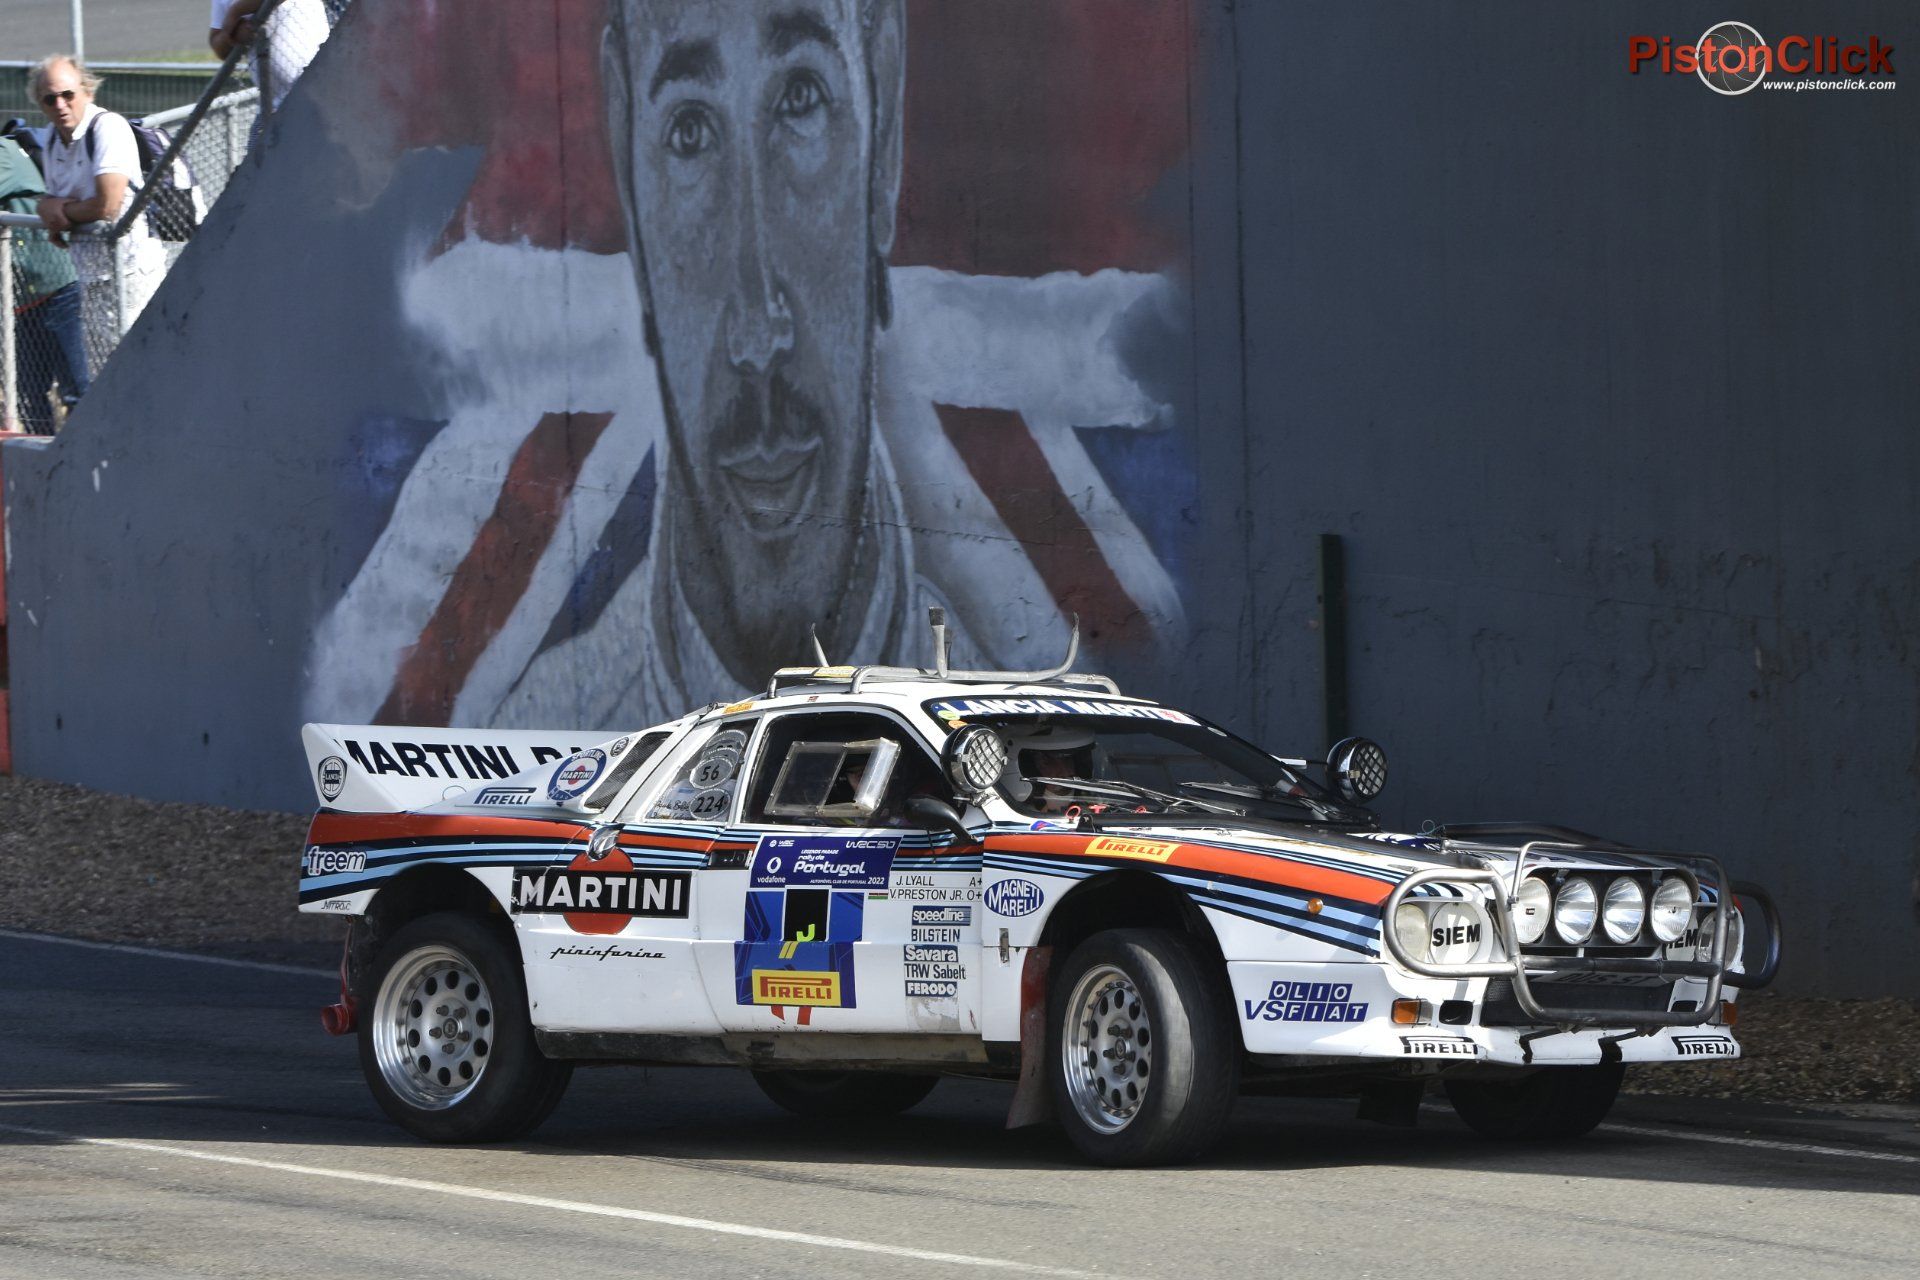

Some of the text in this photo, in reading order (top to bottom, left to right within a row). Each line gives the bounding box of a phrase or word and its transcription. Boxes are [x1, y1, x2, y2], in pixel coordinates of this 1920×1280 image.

[939, 699, 1070, 717] LANCIA
[1062, 701, 1163, 720] MARTI
[344, 739, 520, 780] MARTINI
[561, 771, 592, 780] MARTINI
[700, 764, 720, 781] 56
[474, 787, 537, 805] PIRELLI
[693, 795, 724, 813] 224
[1096, 838, 1168, 856] PIRELLI
[309, 847, 365, 872] freem
[798, 854, 815, 862] rally
[793, 860, 866, 877] Portugal
[867, 876, 885, 885] 2022
[519, 875, 682, 911] MARTINI
[912, 908, 964, 923] speedline
[911, 928, 961, 942] BILSTEIN
[1432, 923, 1480, 947] SIEM
[550, 945, 666, 961] pininfarina
[905, 945, 957, 962] Savara
[904, 963, 966, 979] TRW Sabelt
[760, 976, 832, 999] PIRELLI
[907, 982, 955, 995] FERODO
[1271, 982, 1349, 1000] OLIO
[1399, 1035, 1478, 1054] PIRELLI
[1671, 1035, 1735, 1055] PIRELLI
